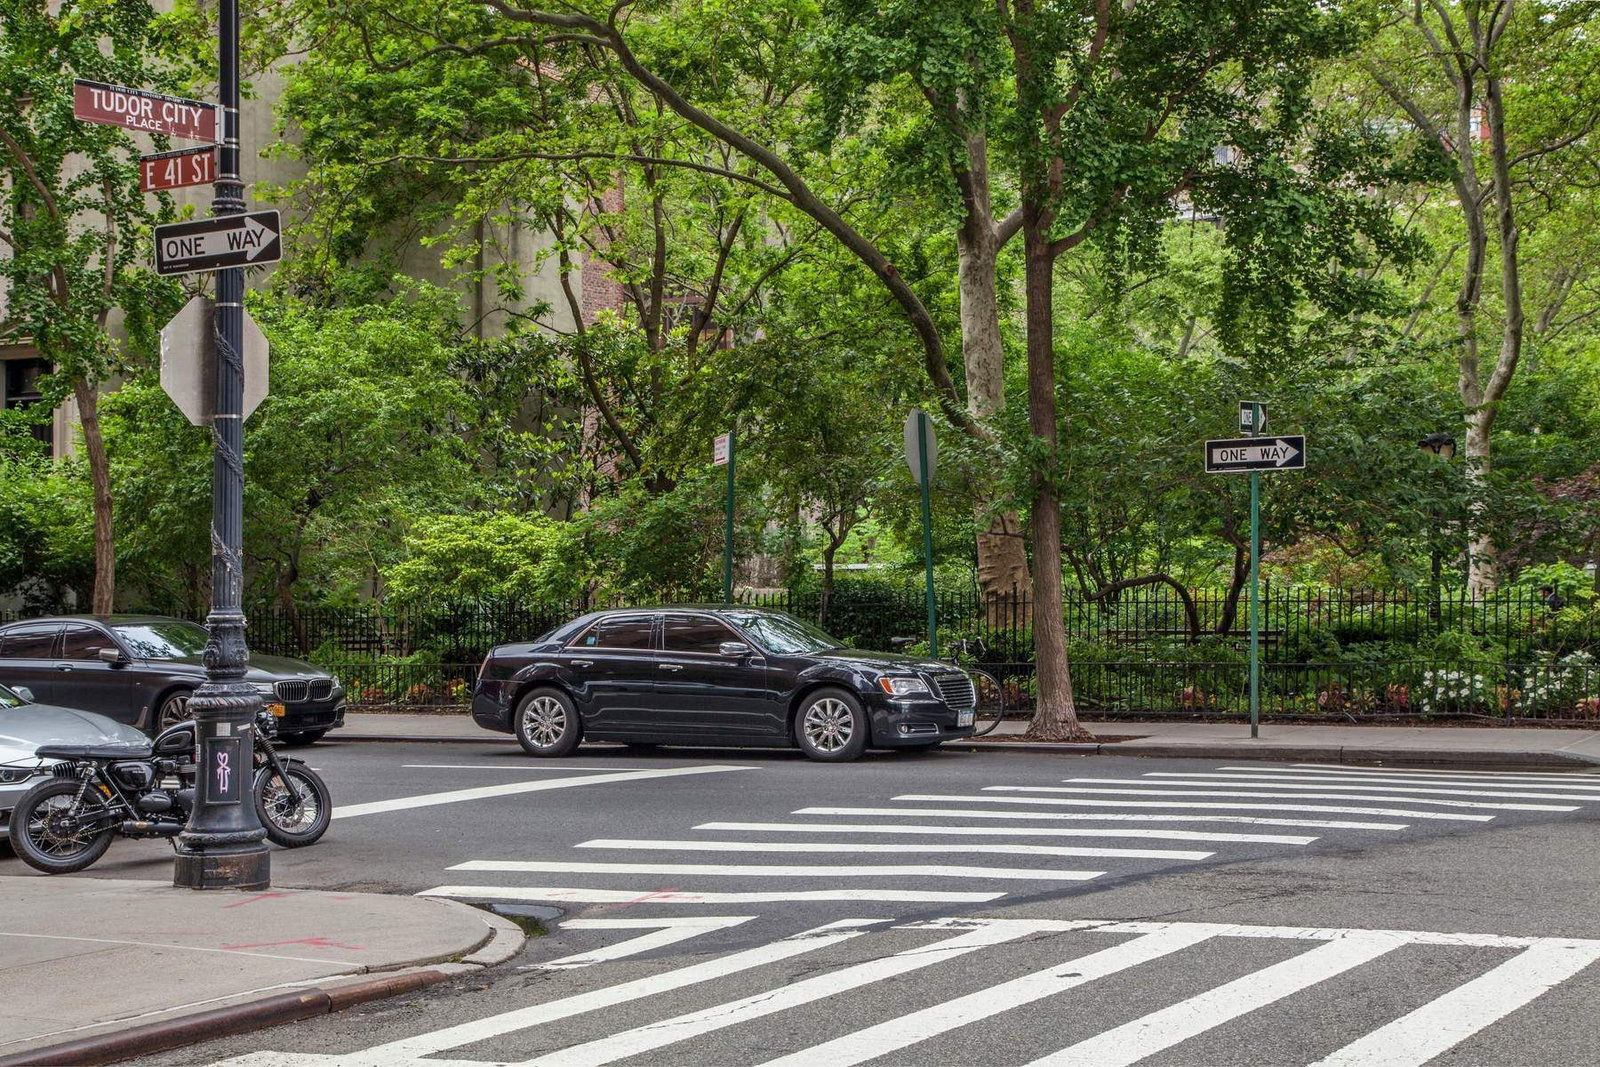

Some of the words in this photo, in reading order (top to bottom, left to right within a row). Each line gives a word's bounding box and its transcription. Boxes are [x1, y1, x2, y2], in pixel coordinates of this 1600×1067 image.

[90, 88, 153, 118] TUDOR
[162, 102, 203, 127] CITY
[126, 115, 162, 131] PLACE
[146, 162, 156, 189] E
[164, 158, 182, 185] 41
[192, 153, 210, 183] ST
[166, 236, 205, 258] ONE
[227, 228, 265, 251] WAY
[1243, 411, 1252, 424] ONE
[1220, 448, 1248, 462] ONE
[1260, 446, 1289, 460] WAY
